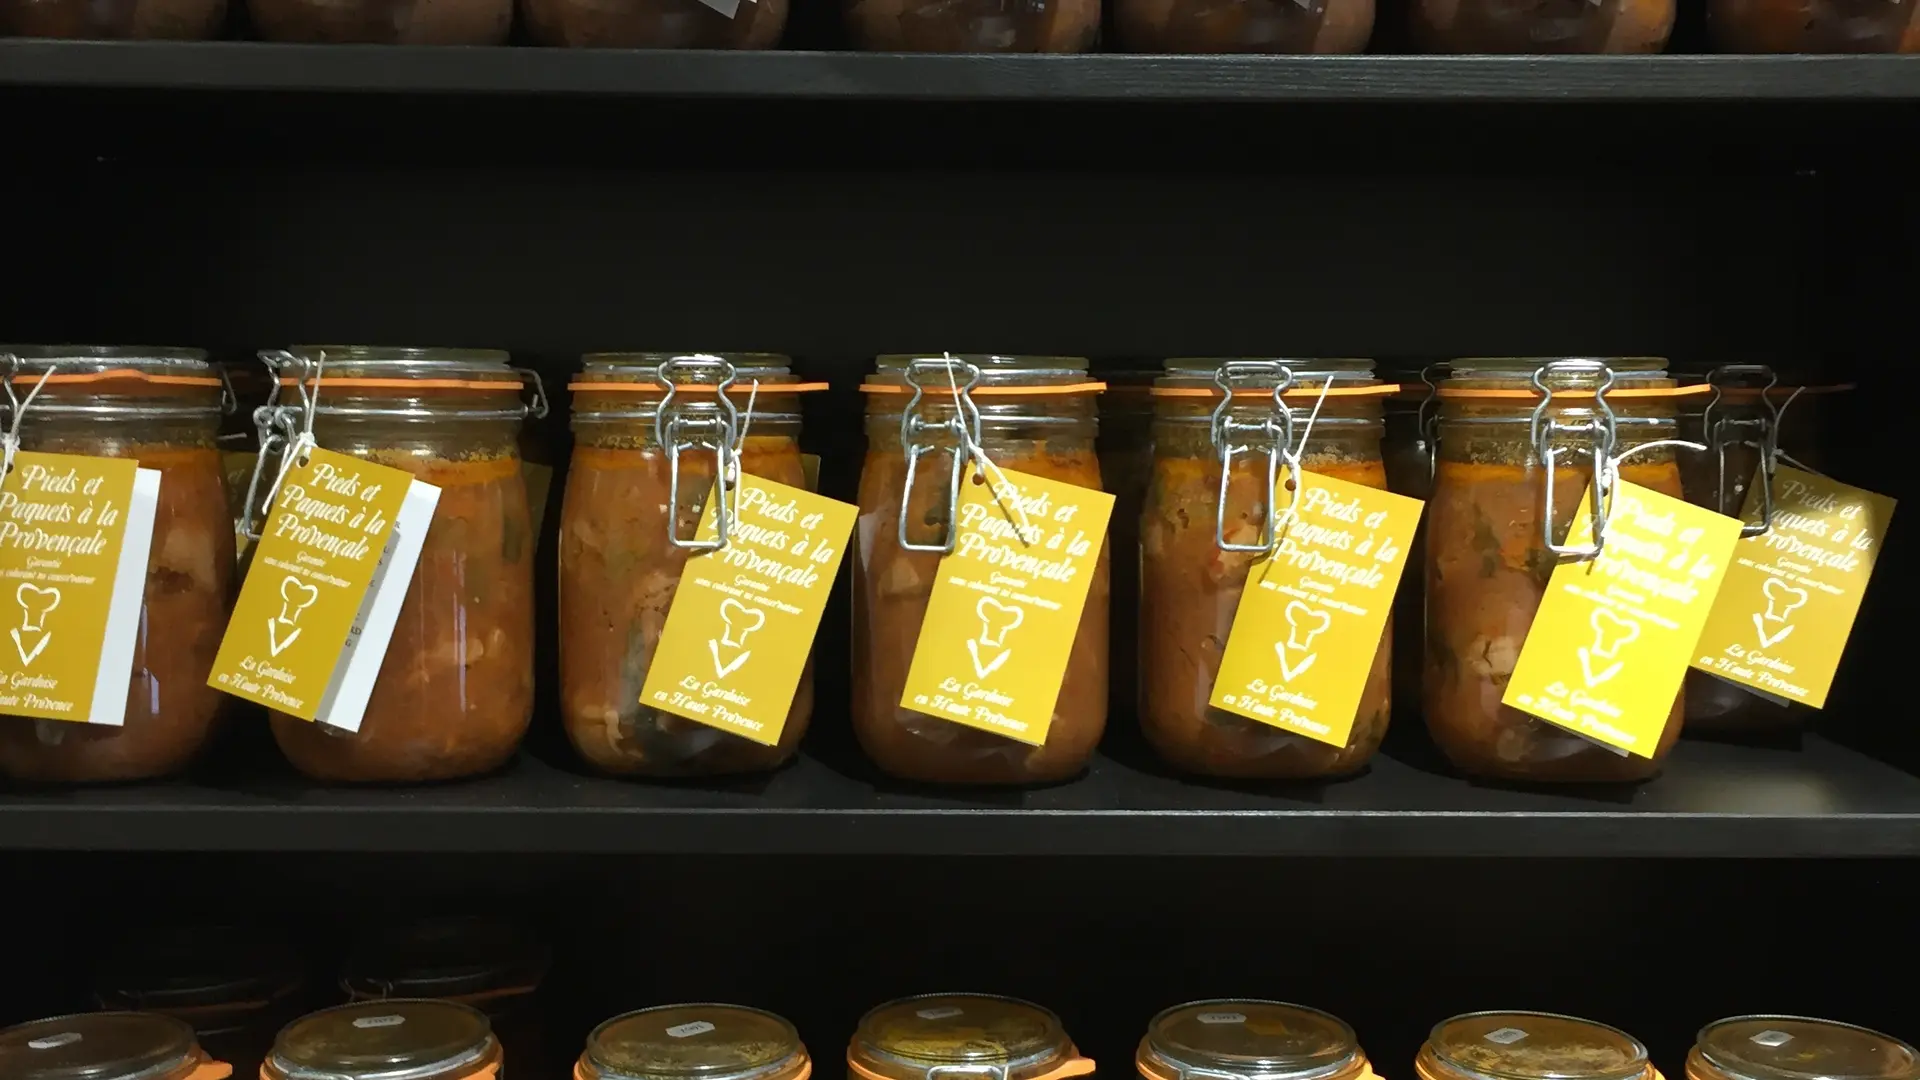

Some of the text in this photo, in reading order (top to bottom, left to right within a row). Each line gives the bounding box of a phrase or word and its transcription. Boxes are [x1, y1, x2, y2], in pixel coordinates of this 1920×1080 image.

[22, 465, 104, 496] Pieds et
[309, 463, 382, 502] Pieds et
[1782, 479, 1863, 520] Pieds et
[0, 492, 118, 526] Paquets à la
[280, 484, 386, 535] Paquets à la
[739, 488, 824, 530] Pieds et
[989, 482, 1078, 523] Pieds et
[1303, 487, 1388, 529] Pieds et
[0, 521, 107, 556] Provençale
[274, 513, 370, 561] Provençale
[791, 533, 809, 556] à
[810, 538, 835, 563] la
[1046, 527, 1065, 549] à
[1066, 530, 1091, 556] la
[1273, 508, 1400, 563] Paquets à la
[1831, 524, 1849, 543] à
[1850, 528, 1874, 551] la
[958, 532, 1076, 582] Provençale
[1270, 538, 1384, 589] Provençale
[678, 675, 701, 690] La
[668, 692, 710, 714] Haute
[712, 705, 764, 732] Provence
